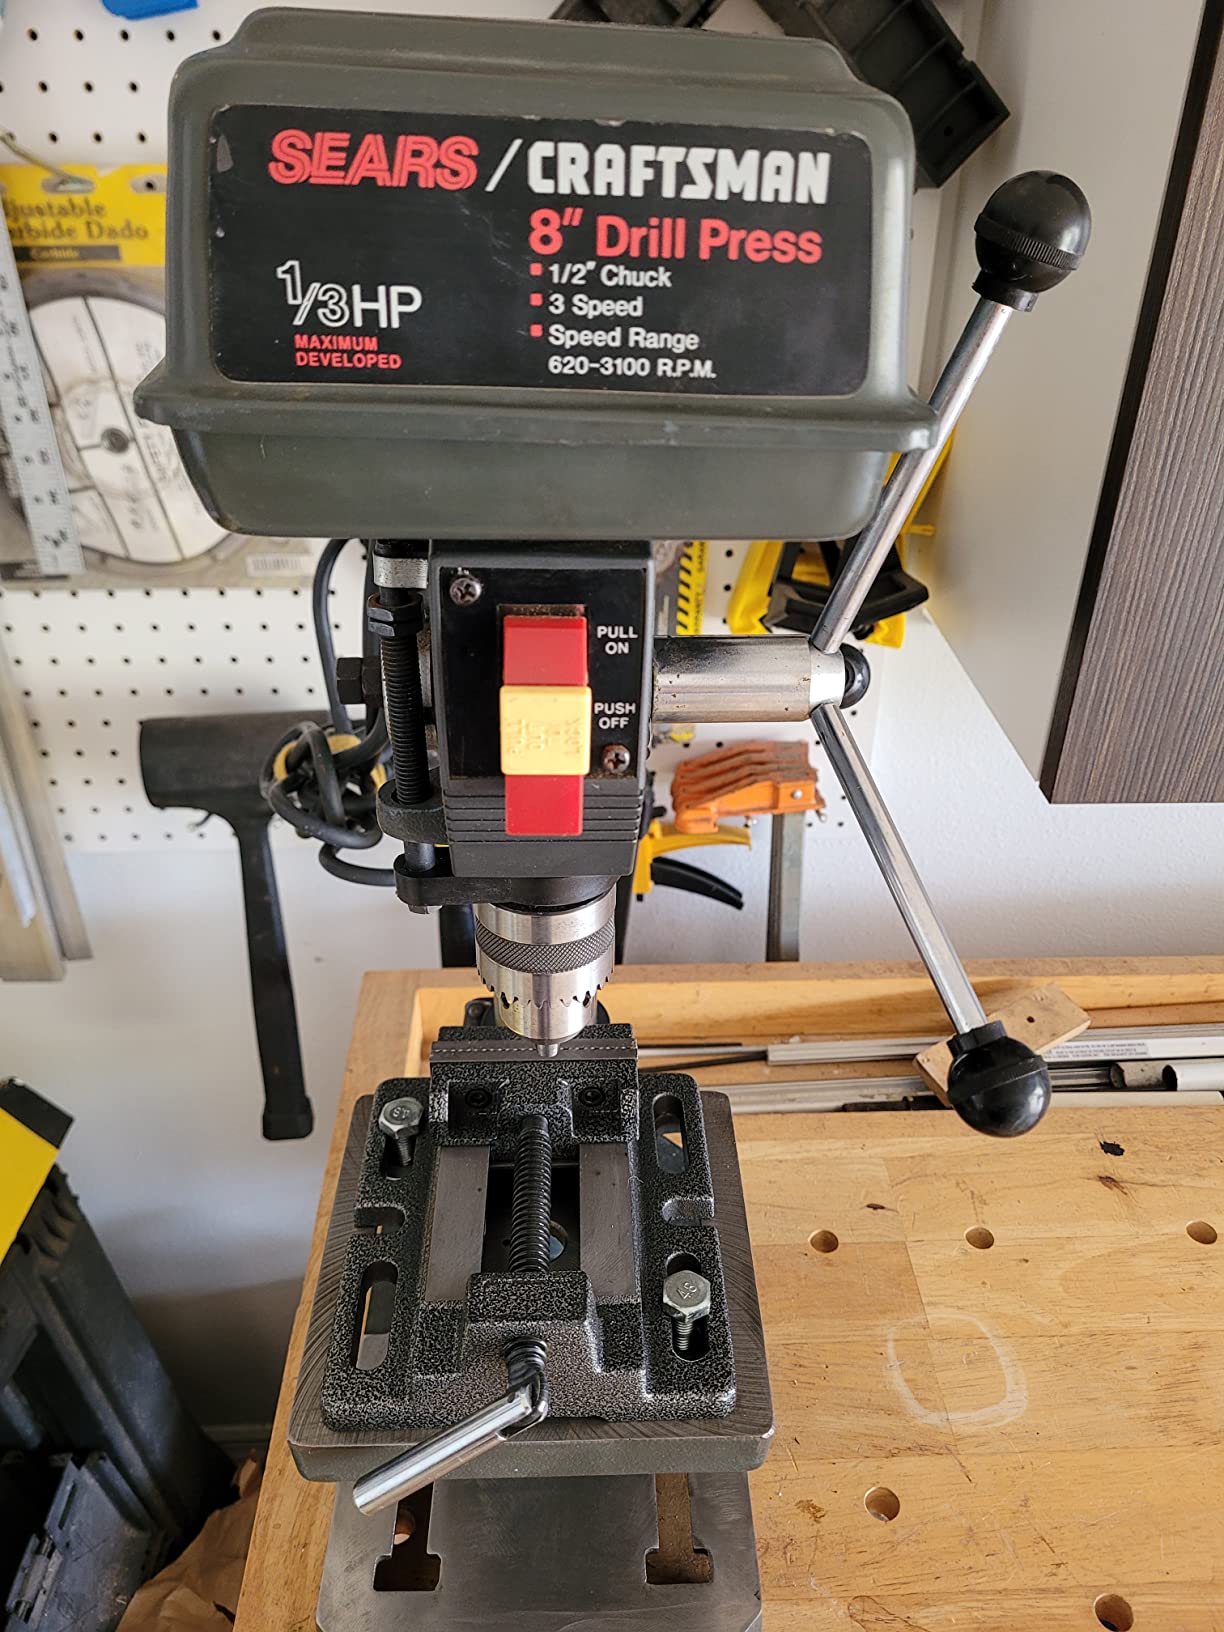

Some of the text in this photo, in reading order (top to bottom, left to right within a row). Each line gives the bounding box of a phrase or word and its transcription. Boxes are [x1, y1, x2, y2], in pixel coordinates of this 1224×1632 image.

[268, 129, 479, 190] SEARS
[528, 141, 831, 204] CRAFTSMAN
[85, 219, 149, 240] Dado
[528, 207, 822, 264] 8" Drill Press
[549, 261, 672, 287] 1/2" Chuck
[549, 294, 643, 319] 3 Speed
[294, 334, 378, 351] MAXIMUM
[548, 324, 699, 353] Speed Range
[296, 352, 402, 369] DEVELOPED
[548, 356, 716, 378] 620-3100 R.P.M.
[597, 626, 638, 638] PULL
[605, 642, 629, 654] ON
[594, 702, 635, 714] PUSH
[599, 717, 629, 729] OFF
